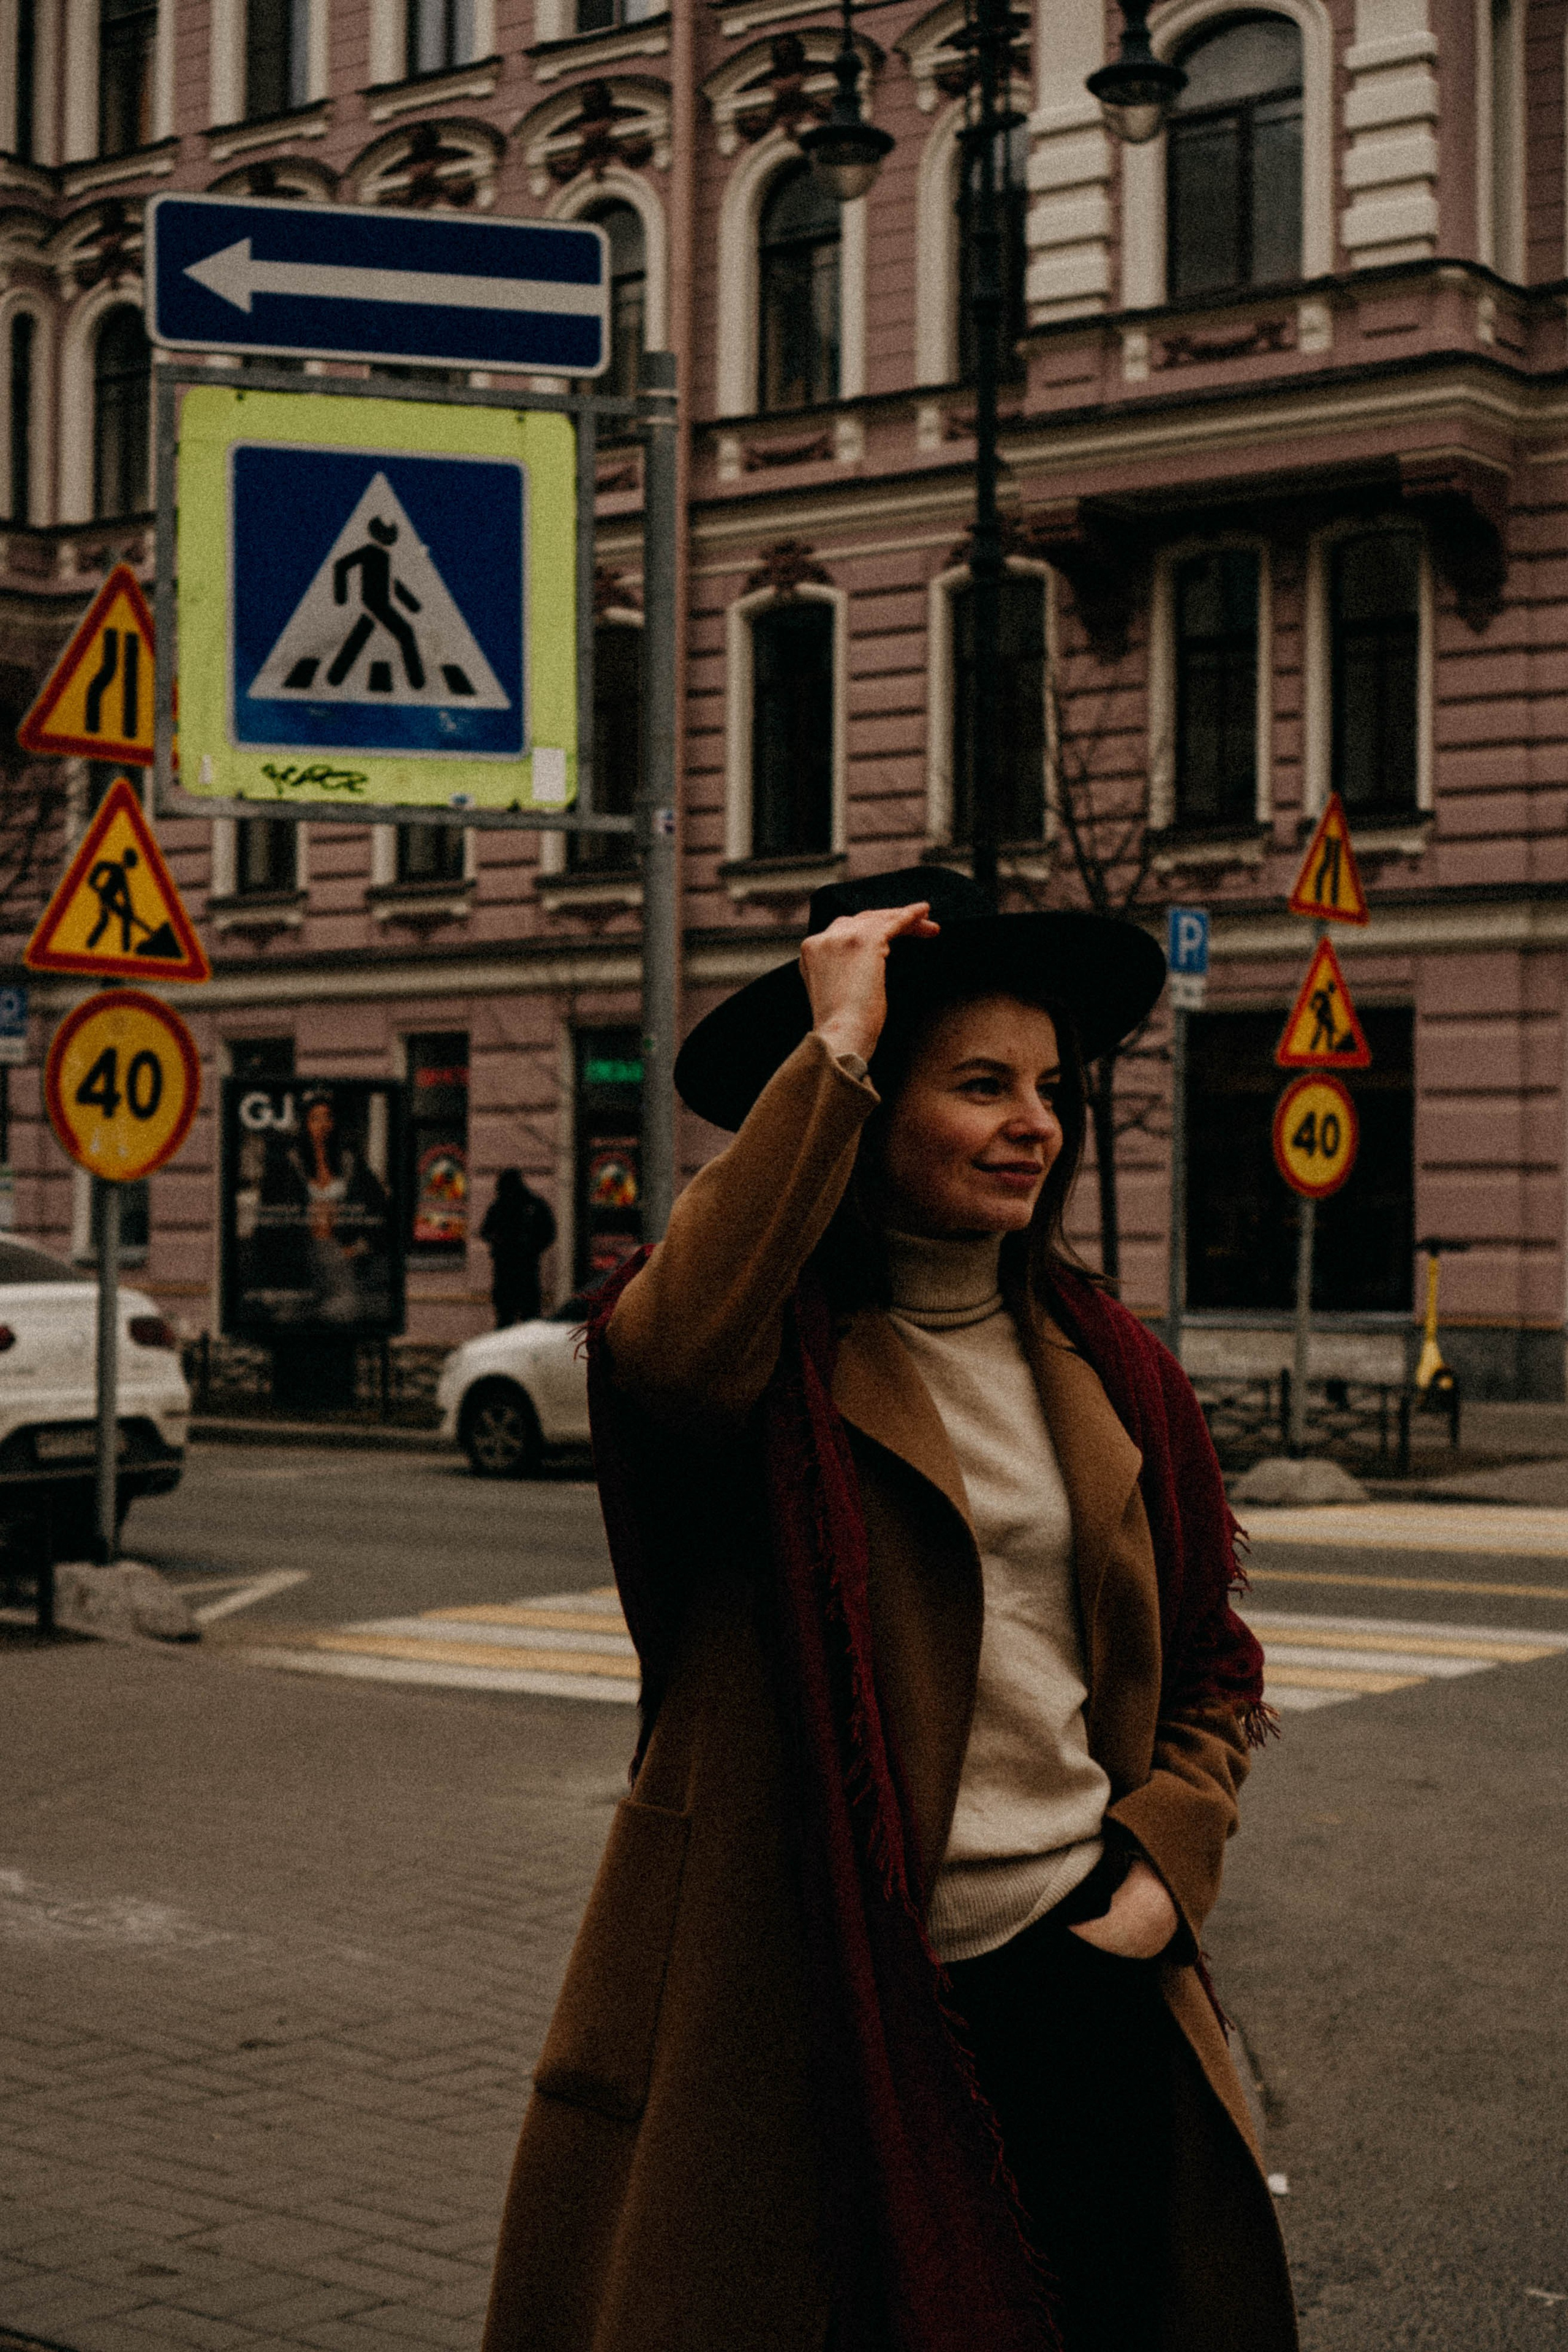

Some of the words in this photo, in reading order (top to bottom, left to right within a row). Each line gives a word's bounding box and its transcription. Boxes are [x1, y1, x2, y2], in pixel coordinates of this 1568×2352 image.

[1178, 914, 1203, 965] P
[76, 1047, 163, 1120] 40
[1292, 1111, 1340, 1158] 40
